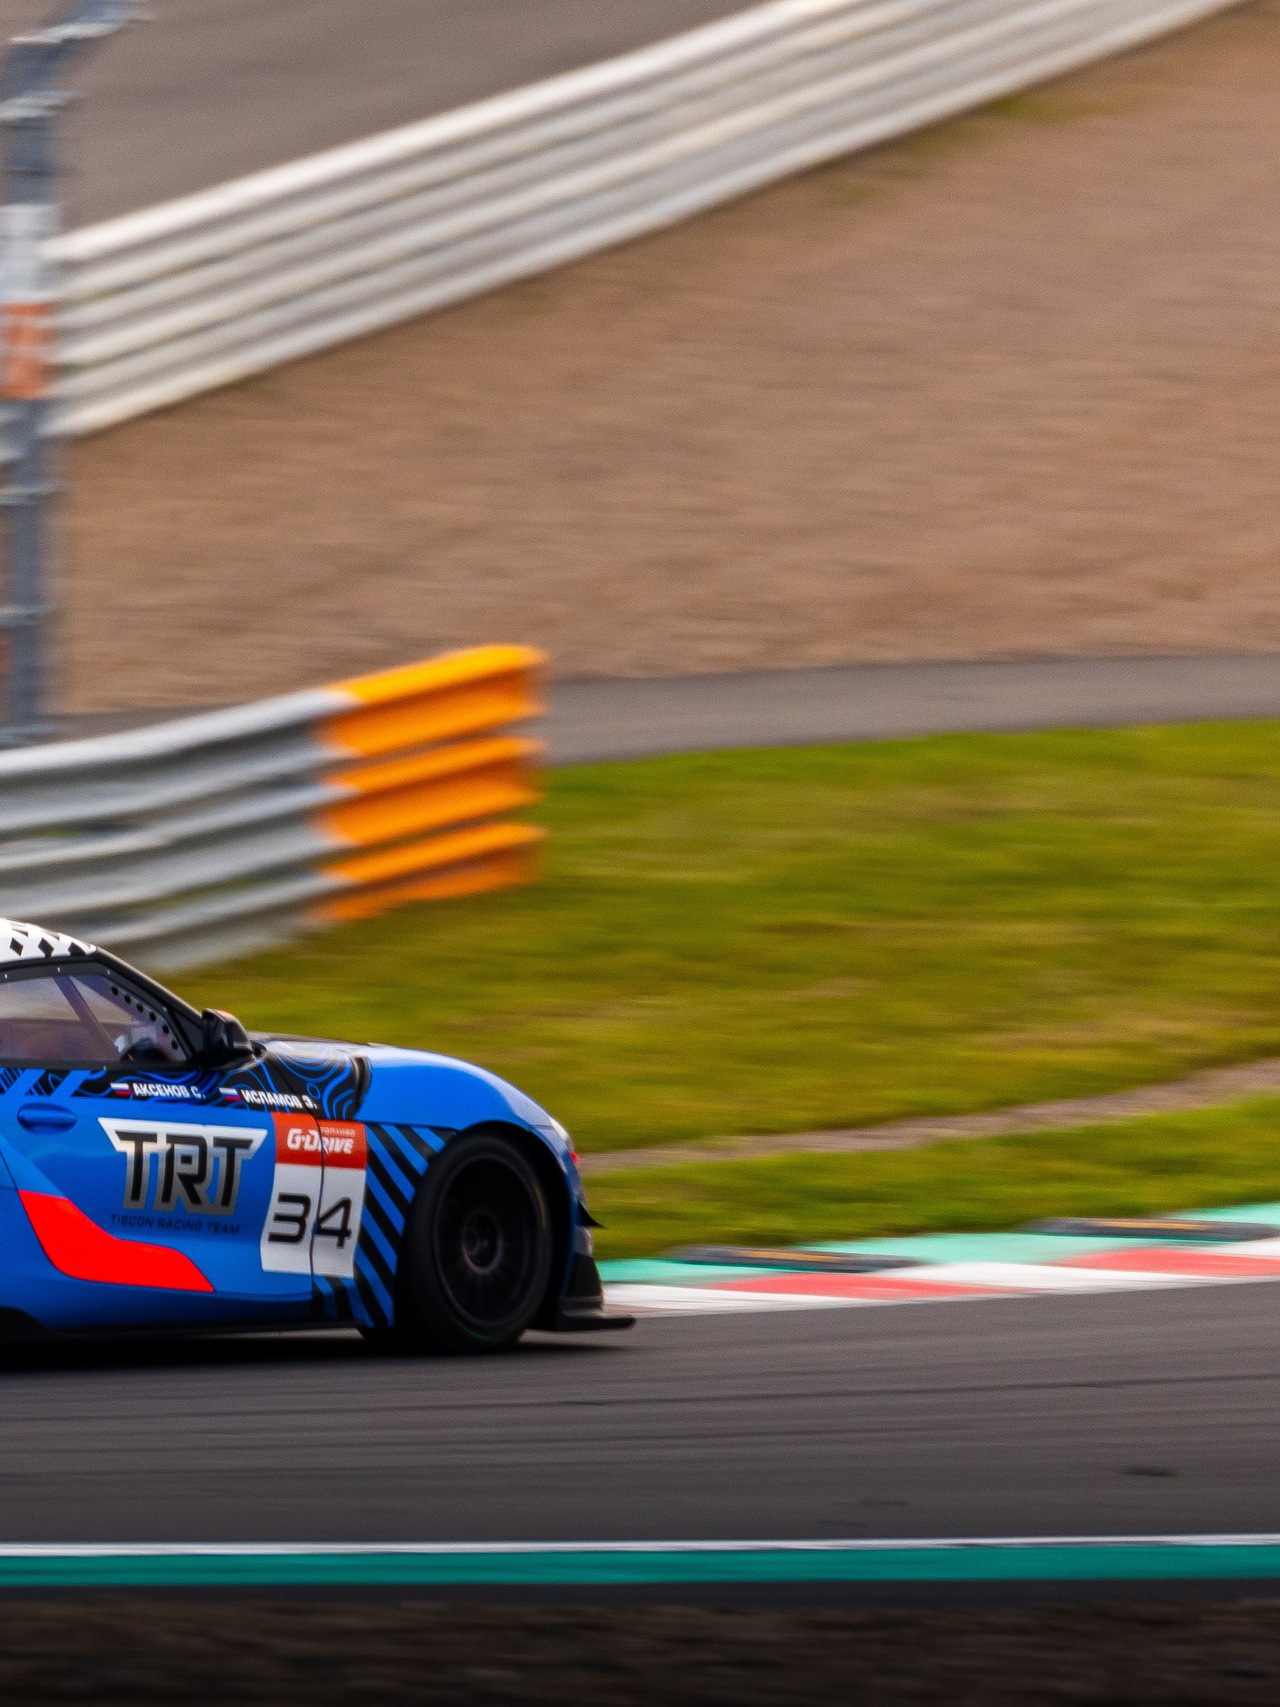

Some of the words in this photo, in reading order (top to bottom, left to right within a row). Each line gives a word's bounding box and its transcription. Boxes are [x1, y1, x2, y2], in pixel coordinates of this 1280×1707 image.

[240, 1089, 303, 1109] ИСЛАМОВ
[104, 1122, 262, 1213] TRT
[110, 1213, 155, 1228] TISCON
[157, 1217, 203, 1233] RACING
[207, 1221, 241, 1235] TEAM
[268, 1191, 352, 1249] 34
